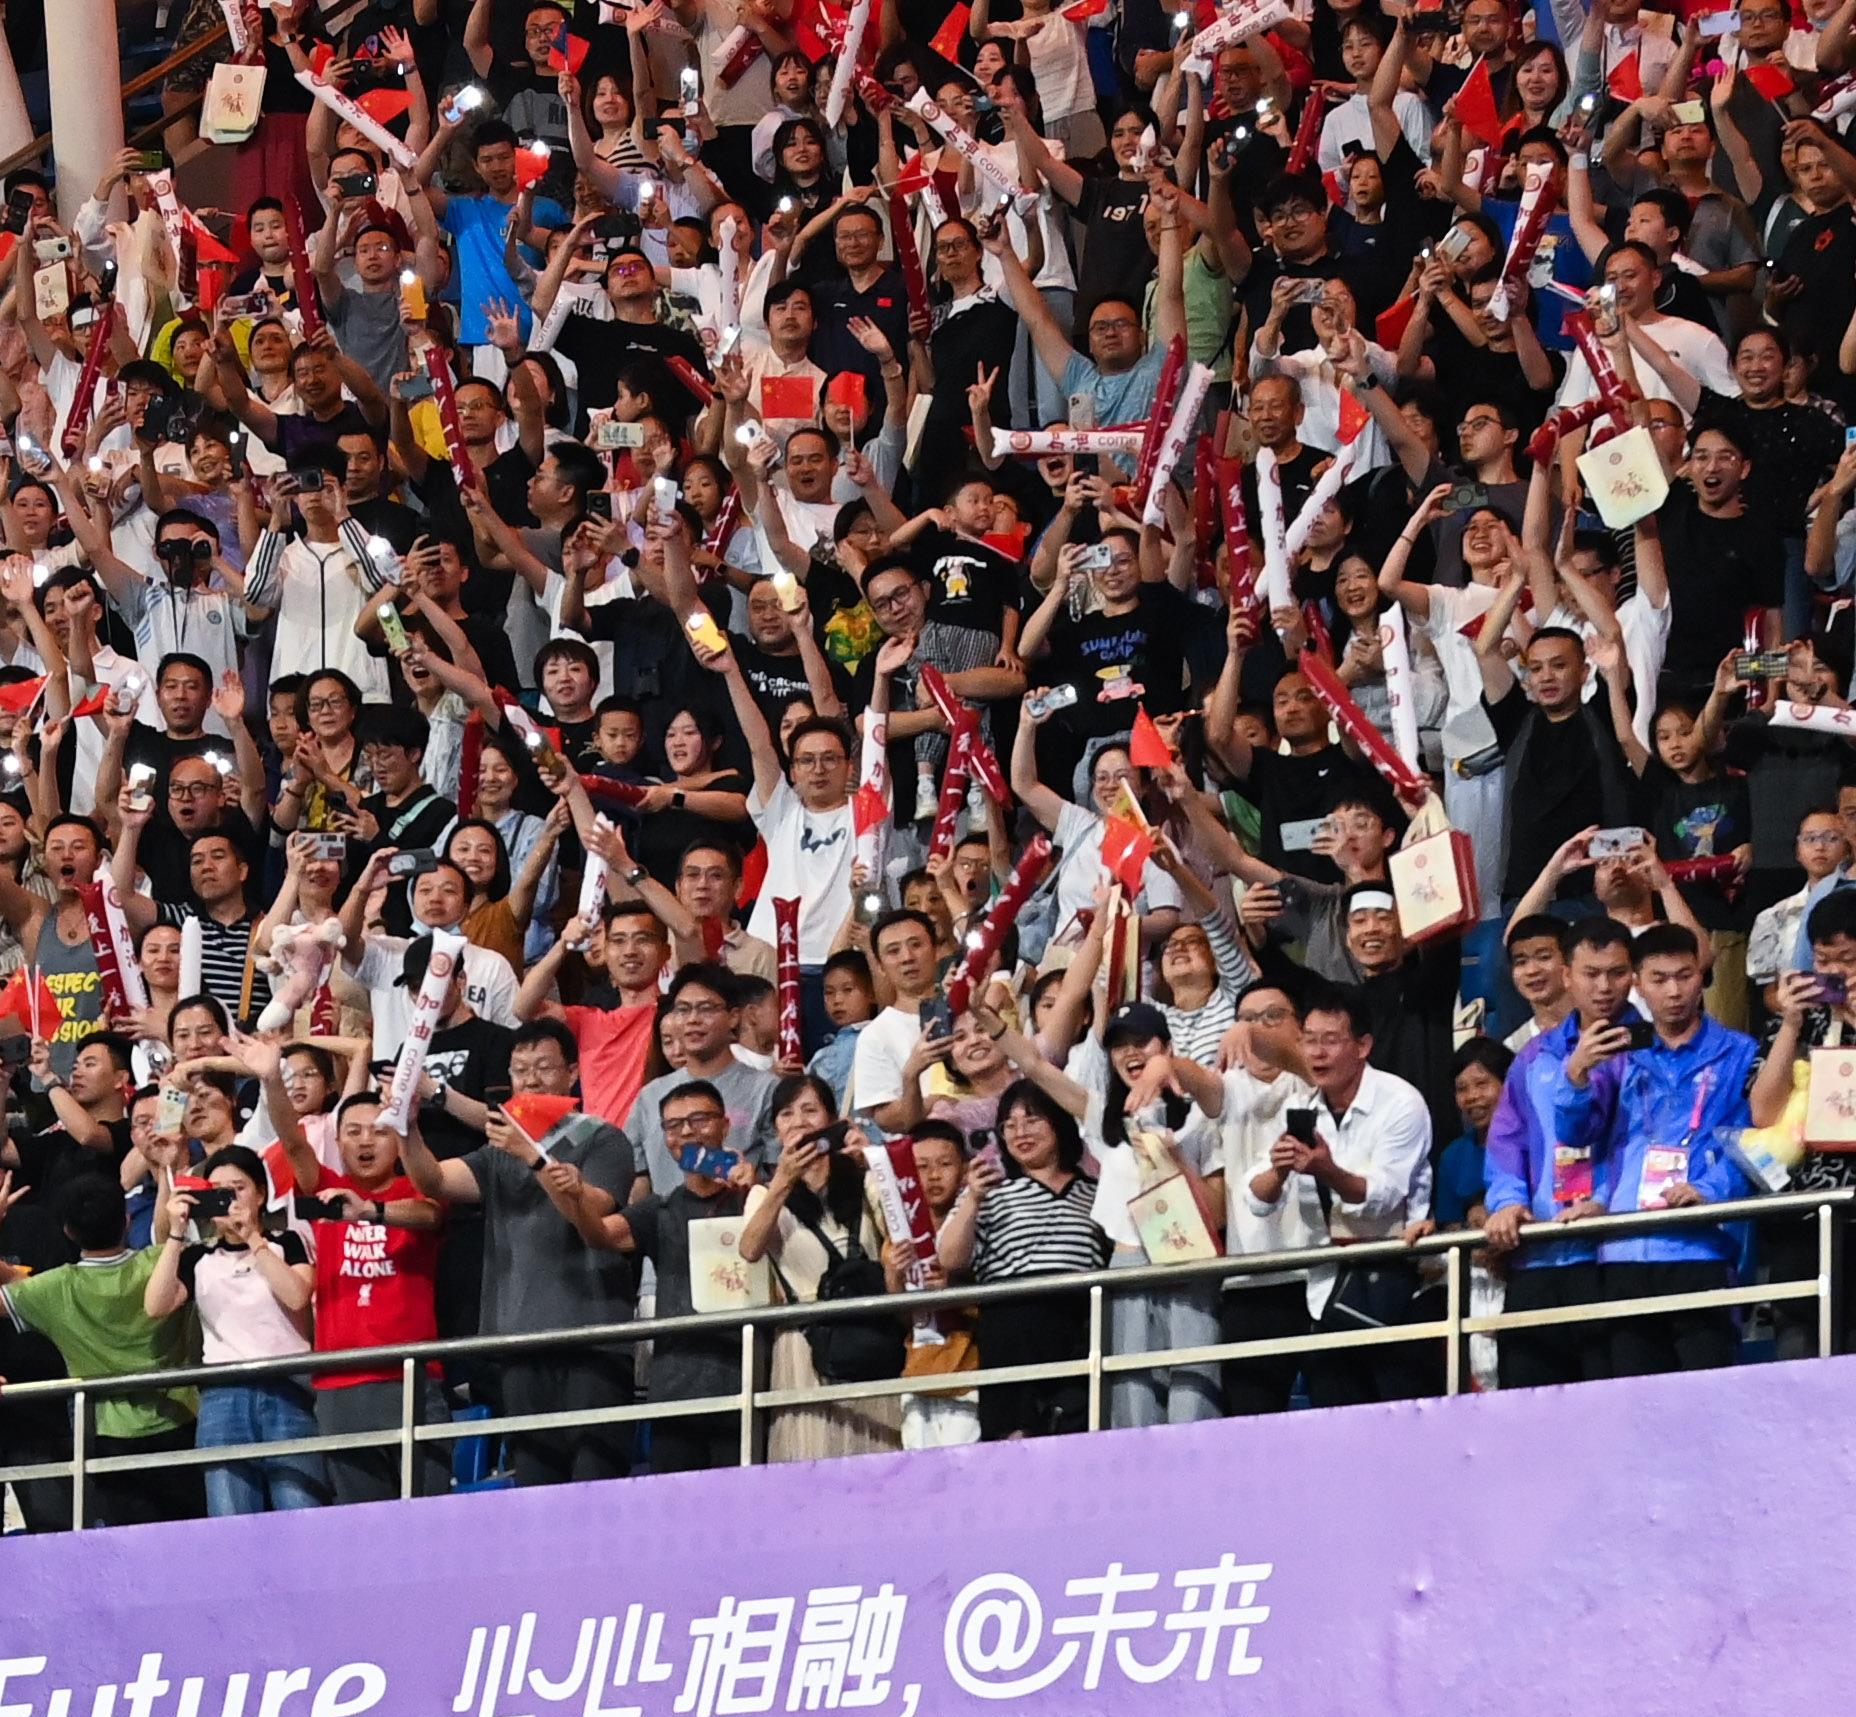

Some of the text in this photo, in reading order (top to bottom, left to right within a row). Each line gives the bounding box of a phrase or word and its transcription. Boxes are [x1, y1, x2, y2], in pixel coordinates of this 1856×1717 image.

[45, 971, 101, 993] ESPEC
[343, 1241, 386, 1260] WALK
[339, 1259, 397, 1278] ALONE
